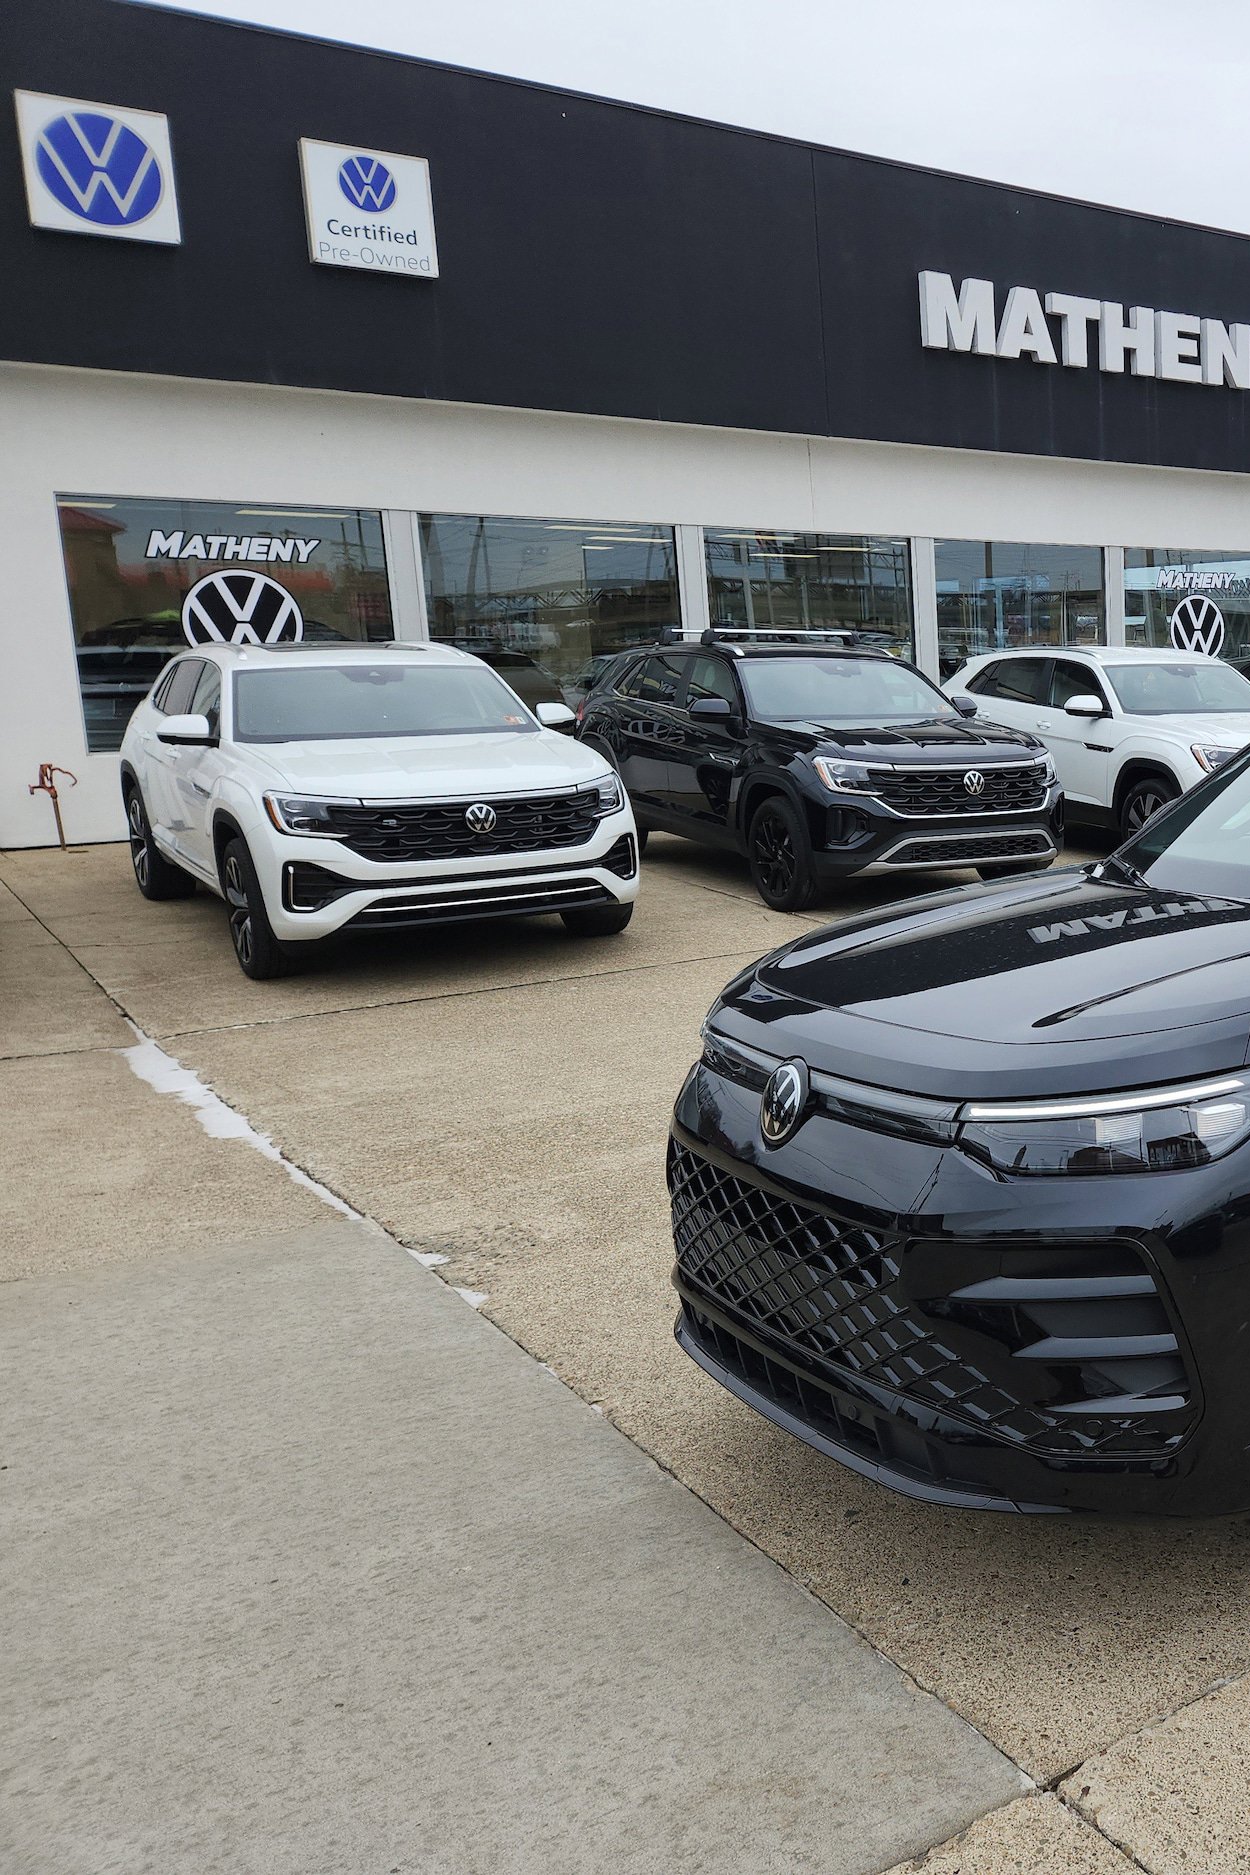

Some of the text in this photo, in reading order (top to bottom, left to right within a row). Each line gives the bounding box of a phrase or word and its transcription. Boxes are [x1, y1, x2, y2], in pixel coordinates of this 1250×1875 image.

[35, 110, 165, 228] VW
[337, 154, 399, 214] VW
[327, 219, 418, 246] Certified
[319, 242, 431, 272] Pre-Owned
[145, 530, 320, 563] MATHENY
[1156, 569, 1236, 590] MATHENY
[1170, 594, 1225, 658] VW
[964, 770, 985, 795] VW
[465, 803, 497, 833] VW
[760, 1063, 801, 1141] VW
